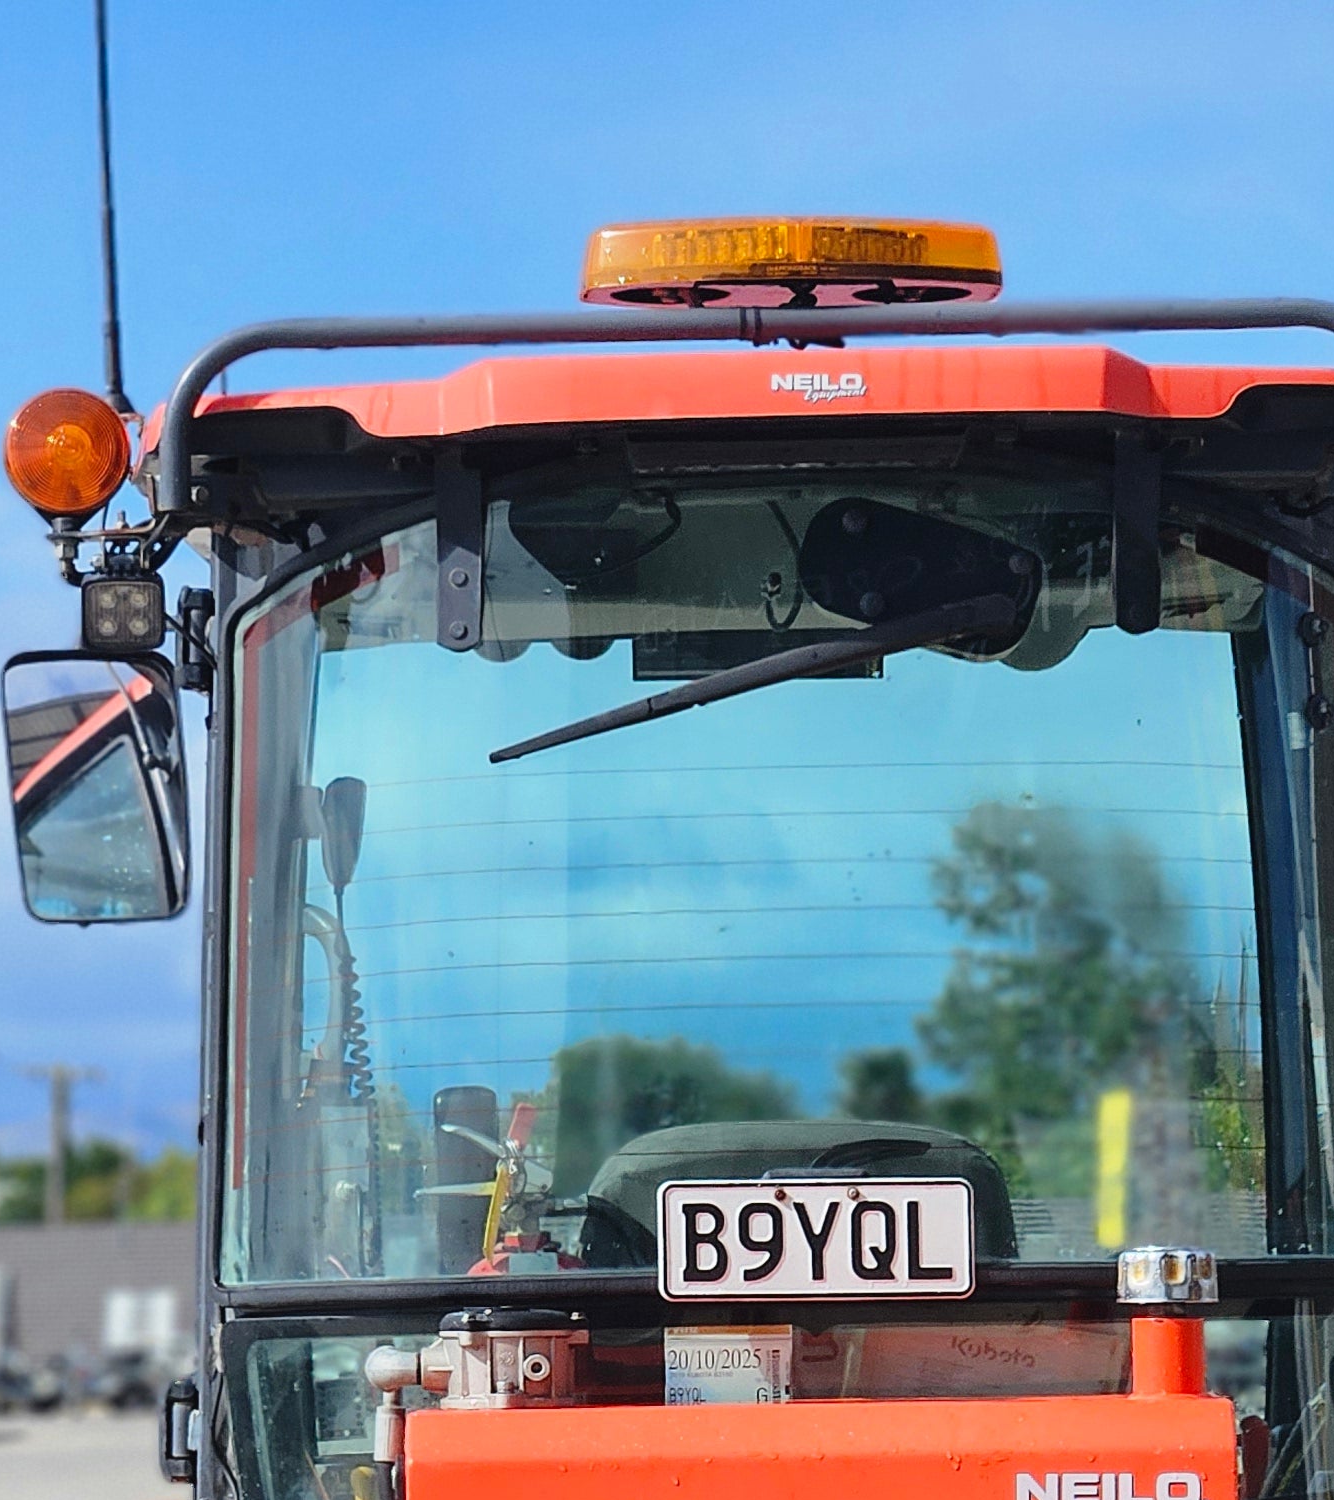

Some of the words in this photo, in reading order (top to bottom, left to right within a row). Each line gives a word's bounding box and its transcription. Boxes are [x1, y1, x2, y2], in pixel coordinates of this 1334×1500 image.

[770, 373, 863, 391] NEILO
[804, 386, 867, 404] Equipment
[682, 1200, 954, 1282] B9YQL
[668, 1348, 762, 1371] 20/10/2025
[951, 1335, 1035, 1368] Kubota
[669, 1387, 706, 1403] B9YQL
